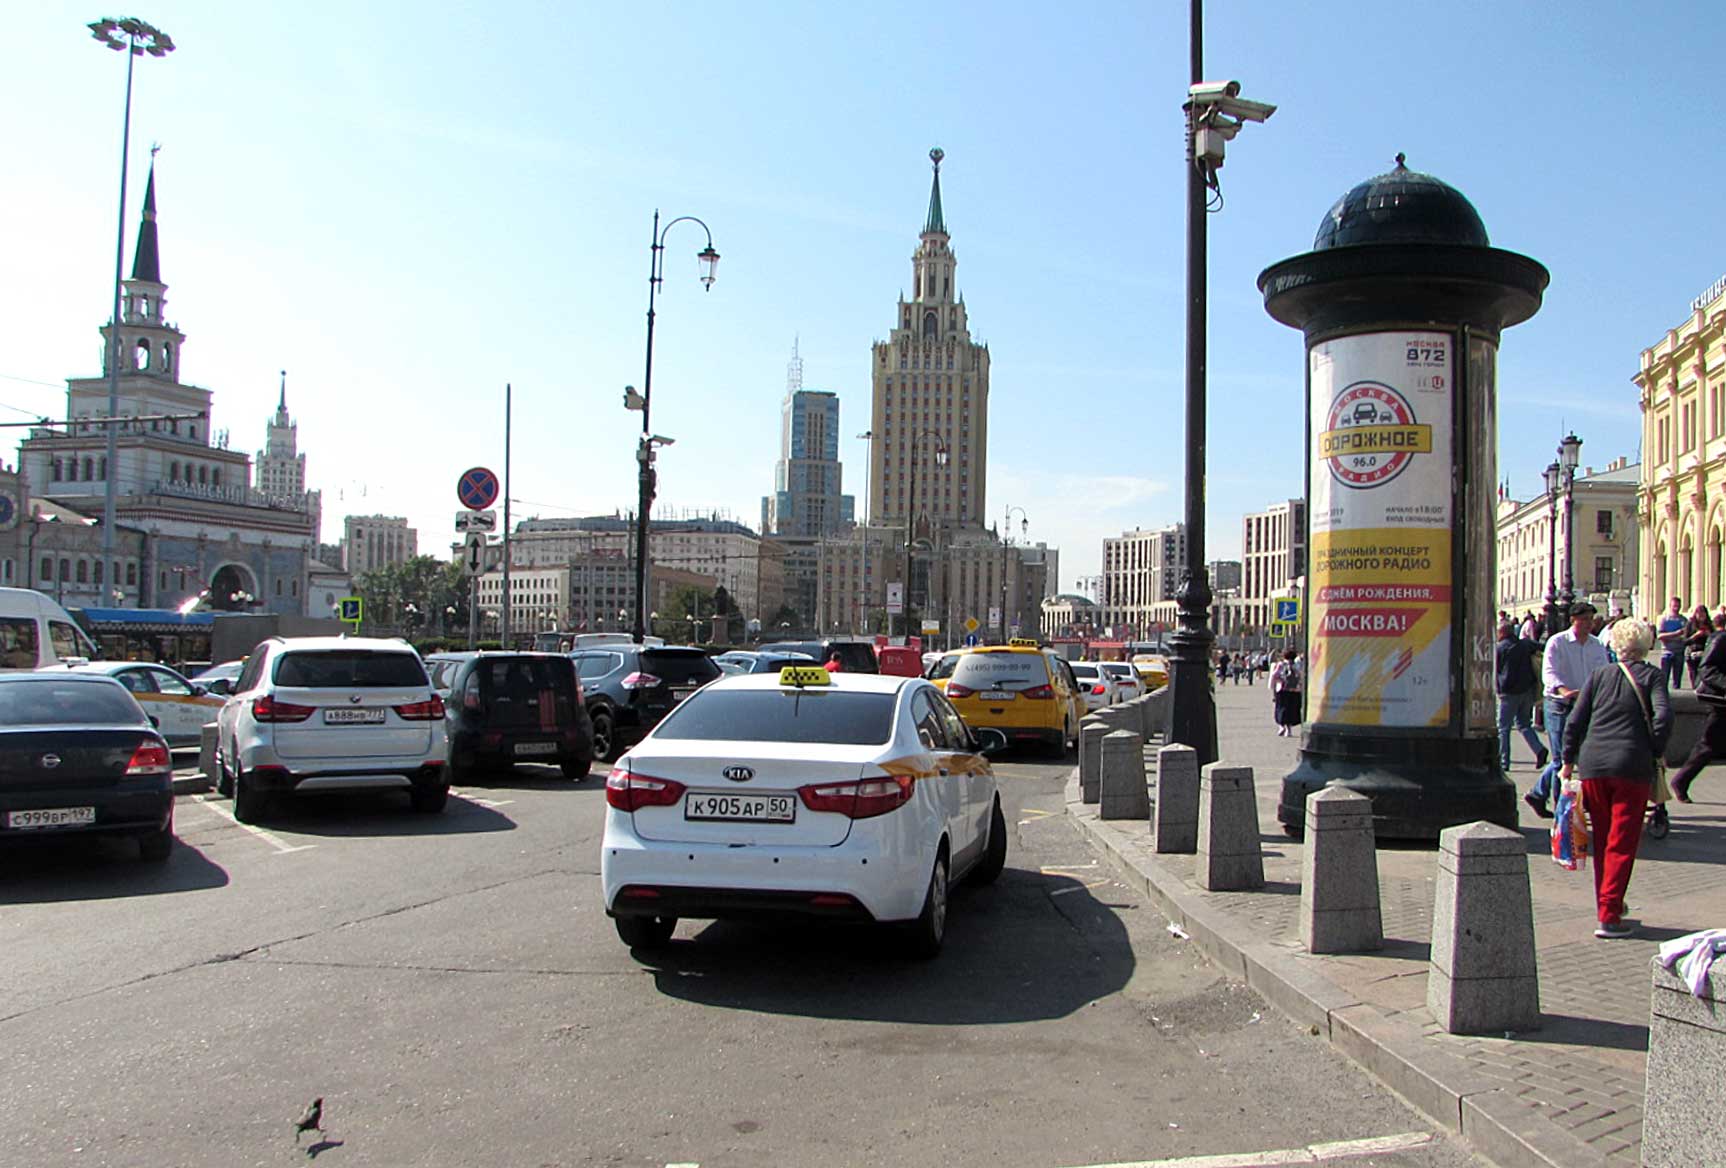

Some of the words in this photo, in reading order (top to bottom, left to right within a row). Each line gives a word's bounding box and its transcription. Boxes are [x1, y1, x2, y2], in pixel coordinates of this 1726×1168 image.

[1406, 349, 1445, 361] 872
[1335, 390, 1399, 414] МОСКВА
[1324, 431, 1418, 452] ДОРОЖНОЕ
[1353, 456, 1376, 467] 96.0
[1338, 463, 1394, 481] РАДИО
[1379, 546, 1429, 557] КОНЦЕРТ
[1316, 558, 1380, 572] ДОРОЖНОГО
[1383, 558, 1431, 571] РАДИО
[1358, 587, 1433, 599] РОЖДЕНИЯ,
[1324, 615, 1408, 631] МОСКВА!
[728, 768, 750, 779] KIA
[769, 798, 788, 812] 50
